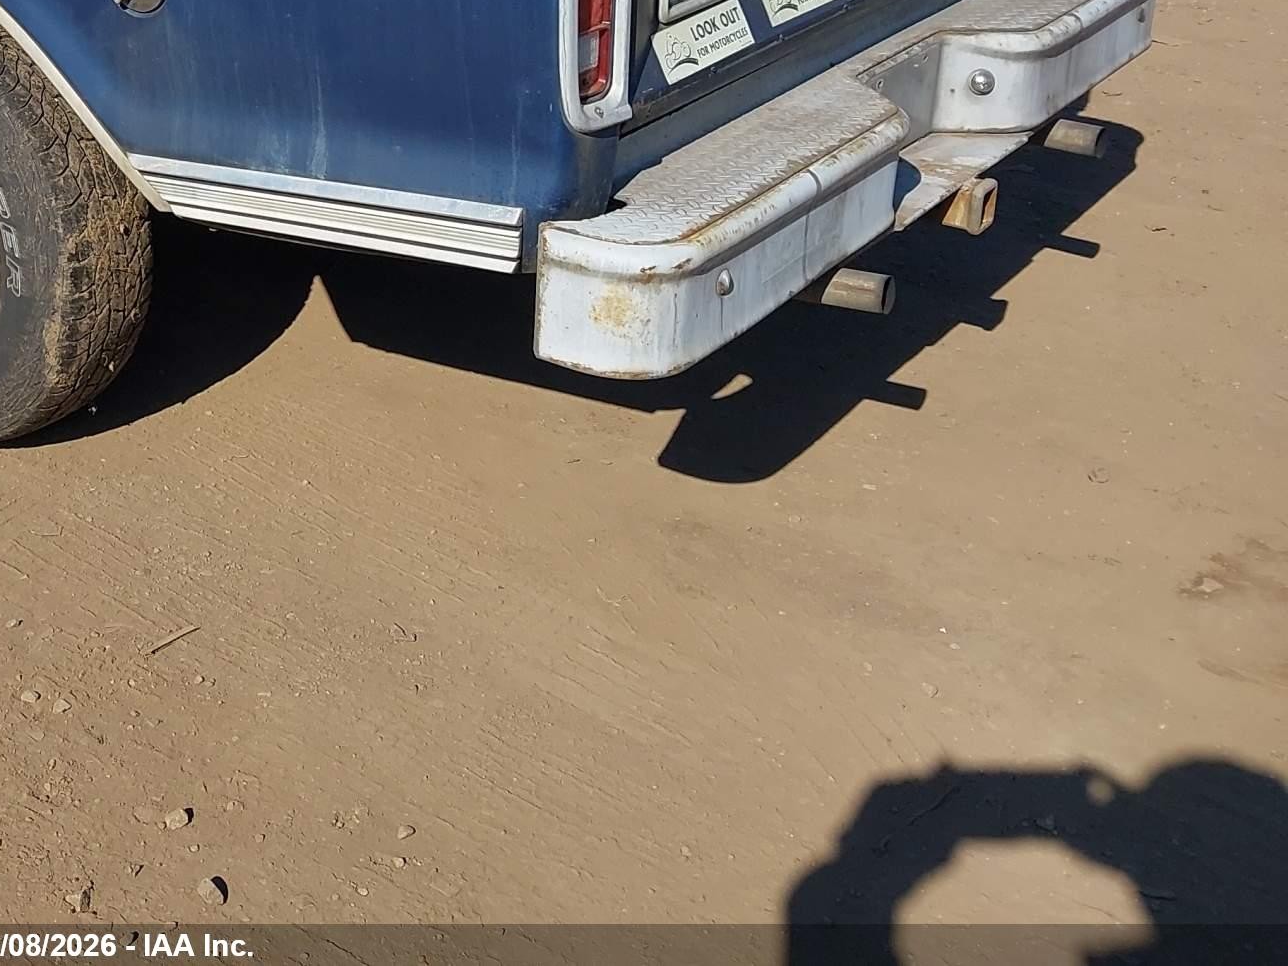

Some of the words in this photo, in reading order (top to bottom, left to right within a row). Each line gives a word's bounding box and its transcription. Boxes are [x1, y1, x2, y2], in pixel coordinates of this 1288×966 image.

[690, 16, 721, 42] LOOK
[719, 7, 741, 28] OUT
[696, 45, 710, 58] FOR
[709, 26, 749, 54] MOTORCYCLES
